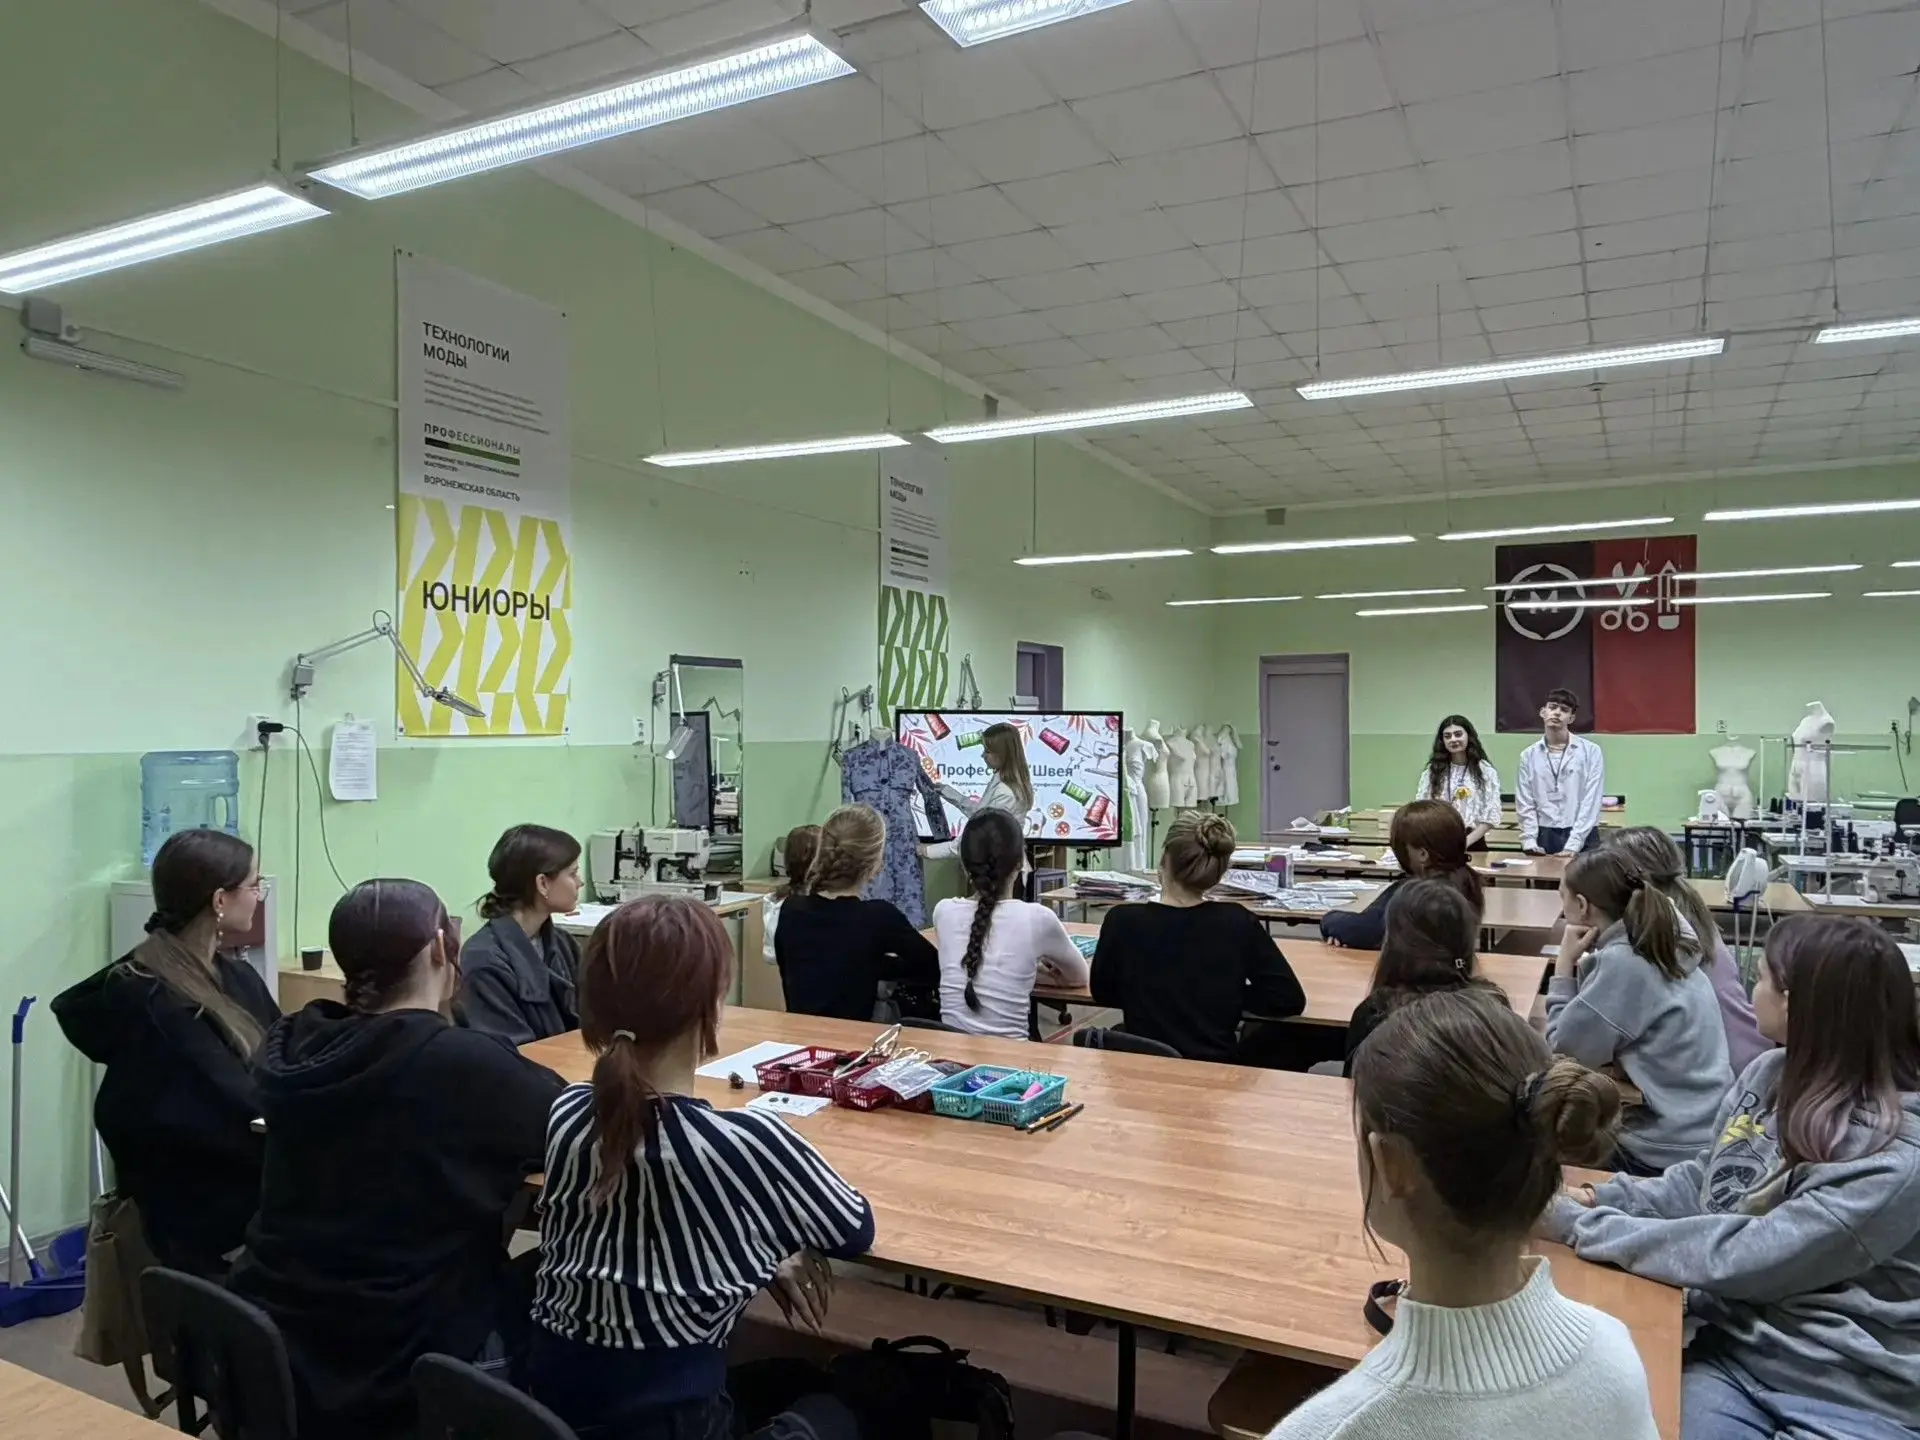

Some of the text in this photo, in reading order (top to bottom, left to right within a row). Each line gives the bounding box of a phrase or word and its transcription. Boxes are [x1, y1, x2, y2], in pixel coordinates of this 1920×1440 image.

[422, 321, 510, 363] ТЕХНОЛОГИИ
[423, 343, 468, 369] МОДЫ
[424, 423, 521, 455] ПРОФЕССИОНАЛЫ
[424, 474, 521, 502] ВОРОНЕЖСКАЯ ОБЛАСТЬ
[422, 580, 550, 621] ЮНИОРЫ
[936, 763, 998, 779] Профес
